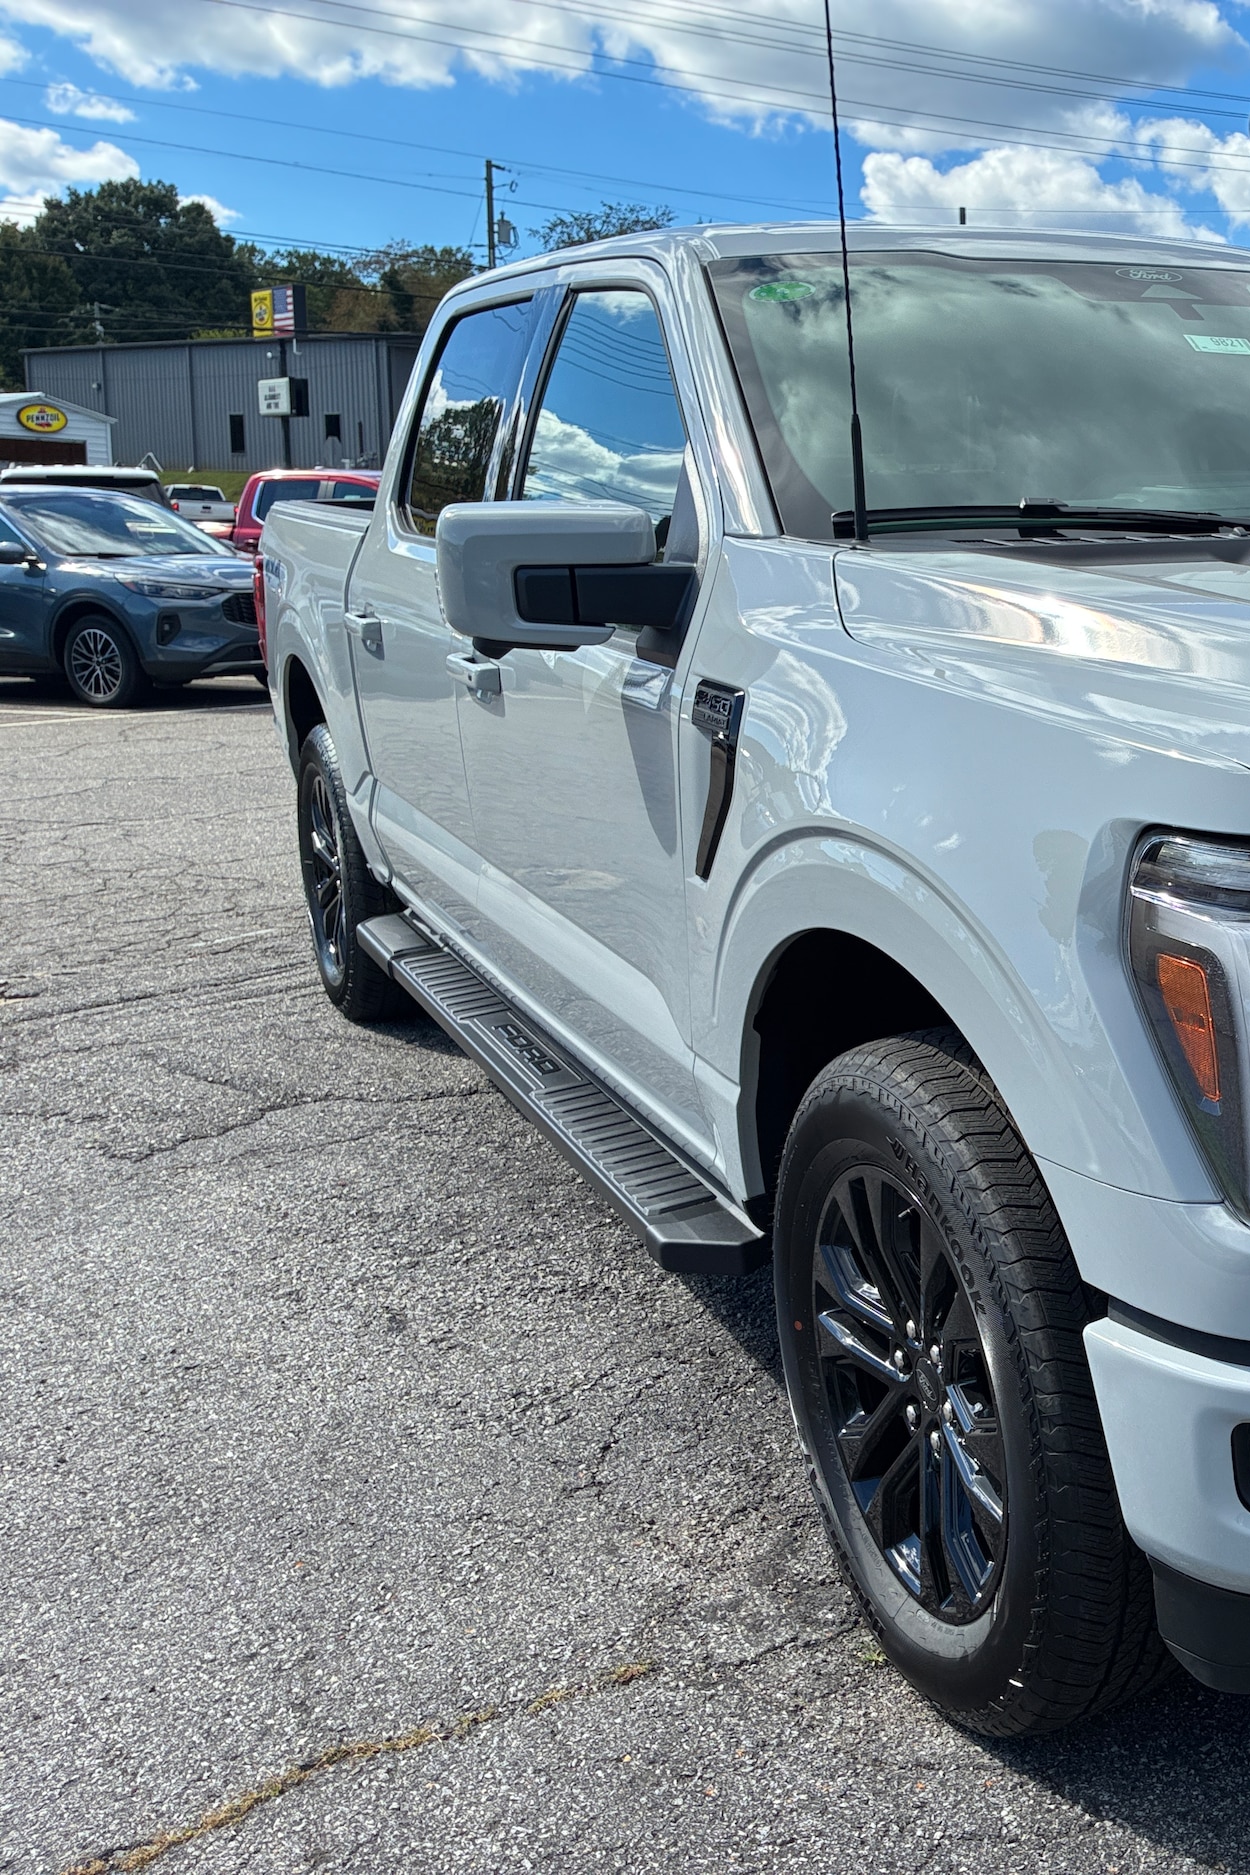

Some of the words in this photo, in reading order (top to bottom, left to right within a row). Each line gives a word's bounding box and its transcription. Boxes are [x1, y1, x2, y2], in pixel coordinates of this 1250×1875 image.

[1129, 269, 1172, 280] Ford
[1210, 337, 1244, 348] 9821
[26, 413, 60, 423] PENNZOIL
[491, 1024, 562, 1076] FORD
